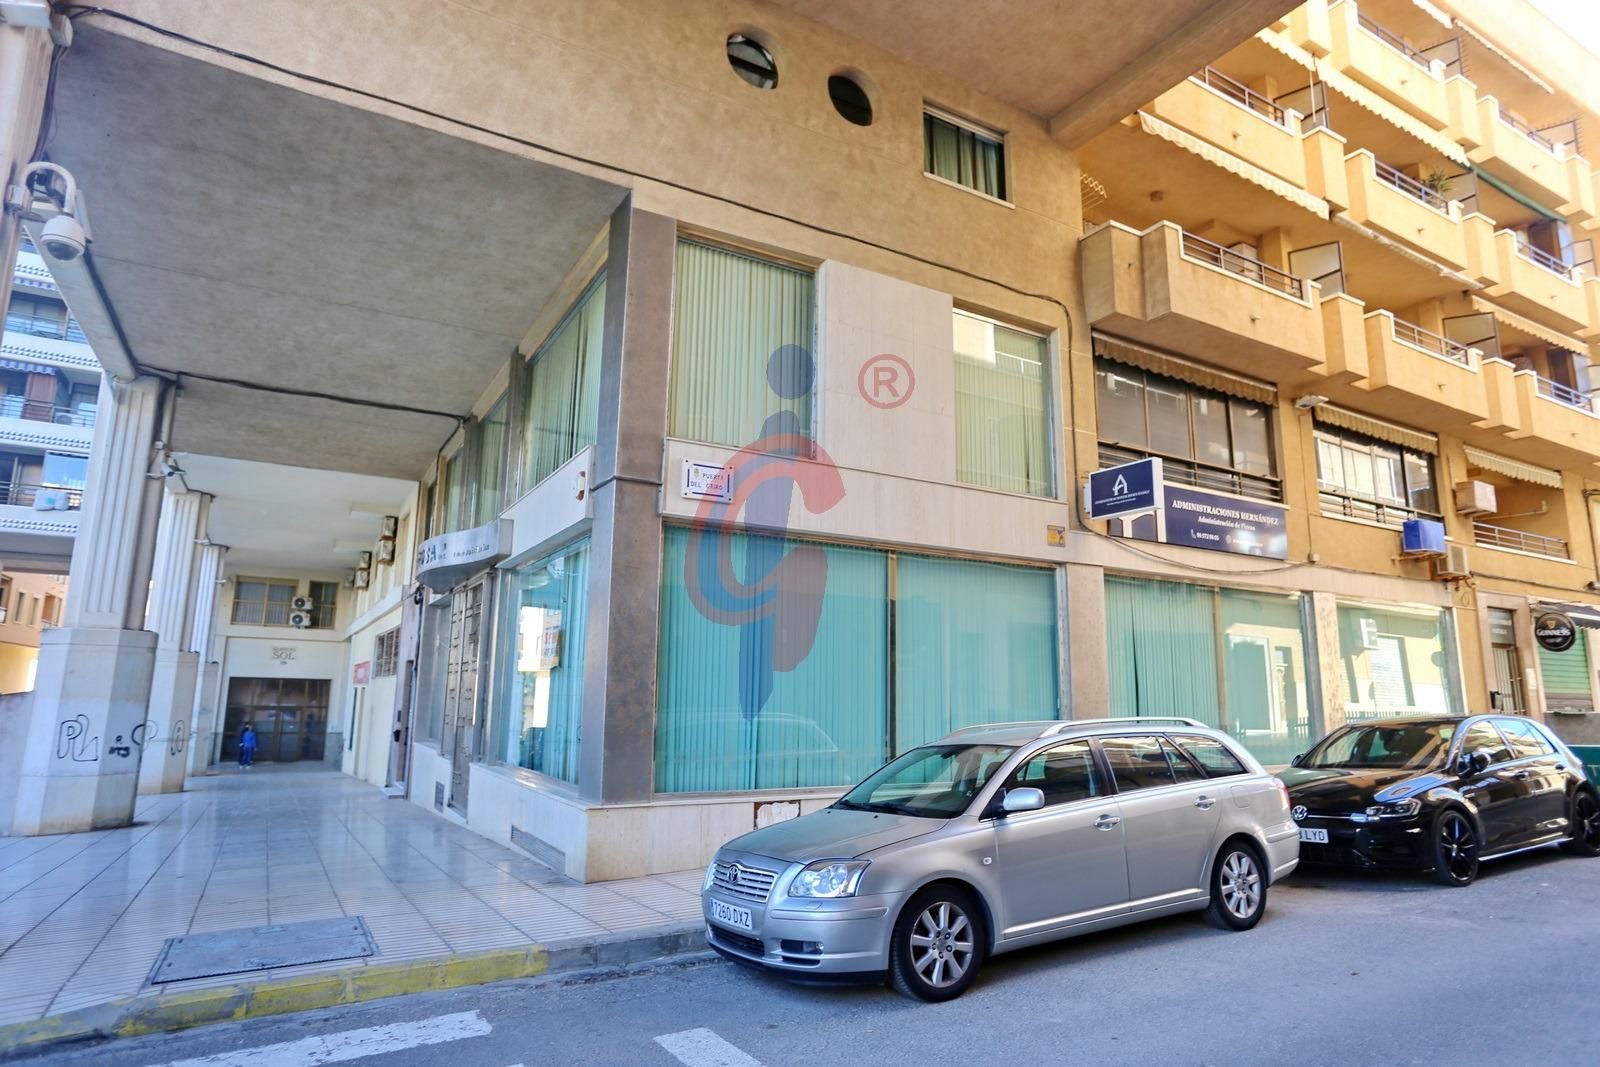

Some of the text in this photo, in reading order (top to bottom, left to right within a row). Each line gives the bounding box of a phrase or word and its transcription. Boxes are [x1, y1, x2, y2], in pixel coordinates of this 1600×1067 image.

[690, 480, 702, 489] DEL
[1172, 499, 1280, 526] ADMINISTRACIONES HERNÁNDEZ
[1198, 515, 1235, 528] Administración
[272, 651, 296, 660] SOL
[714, 901, 750, 928] 7260 DXZ
